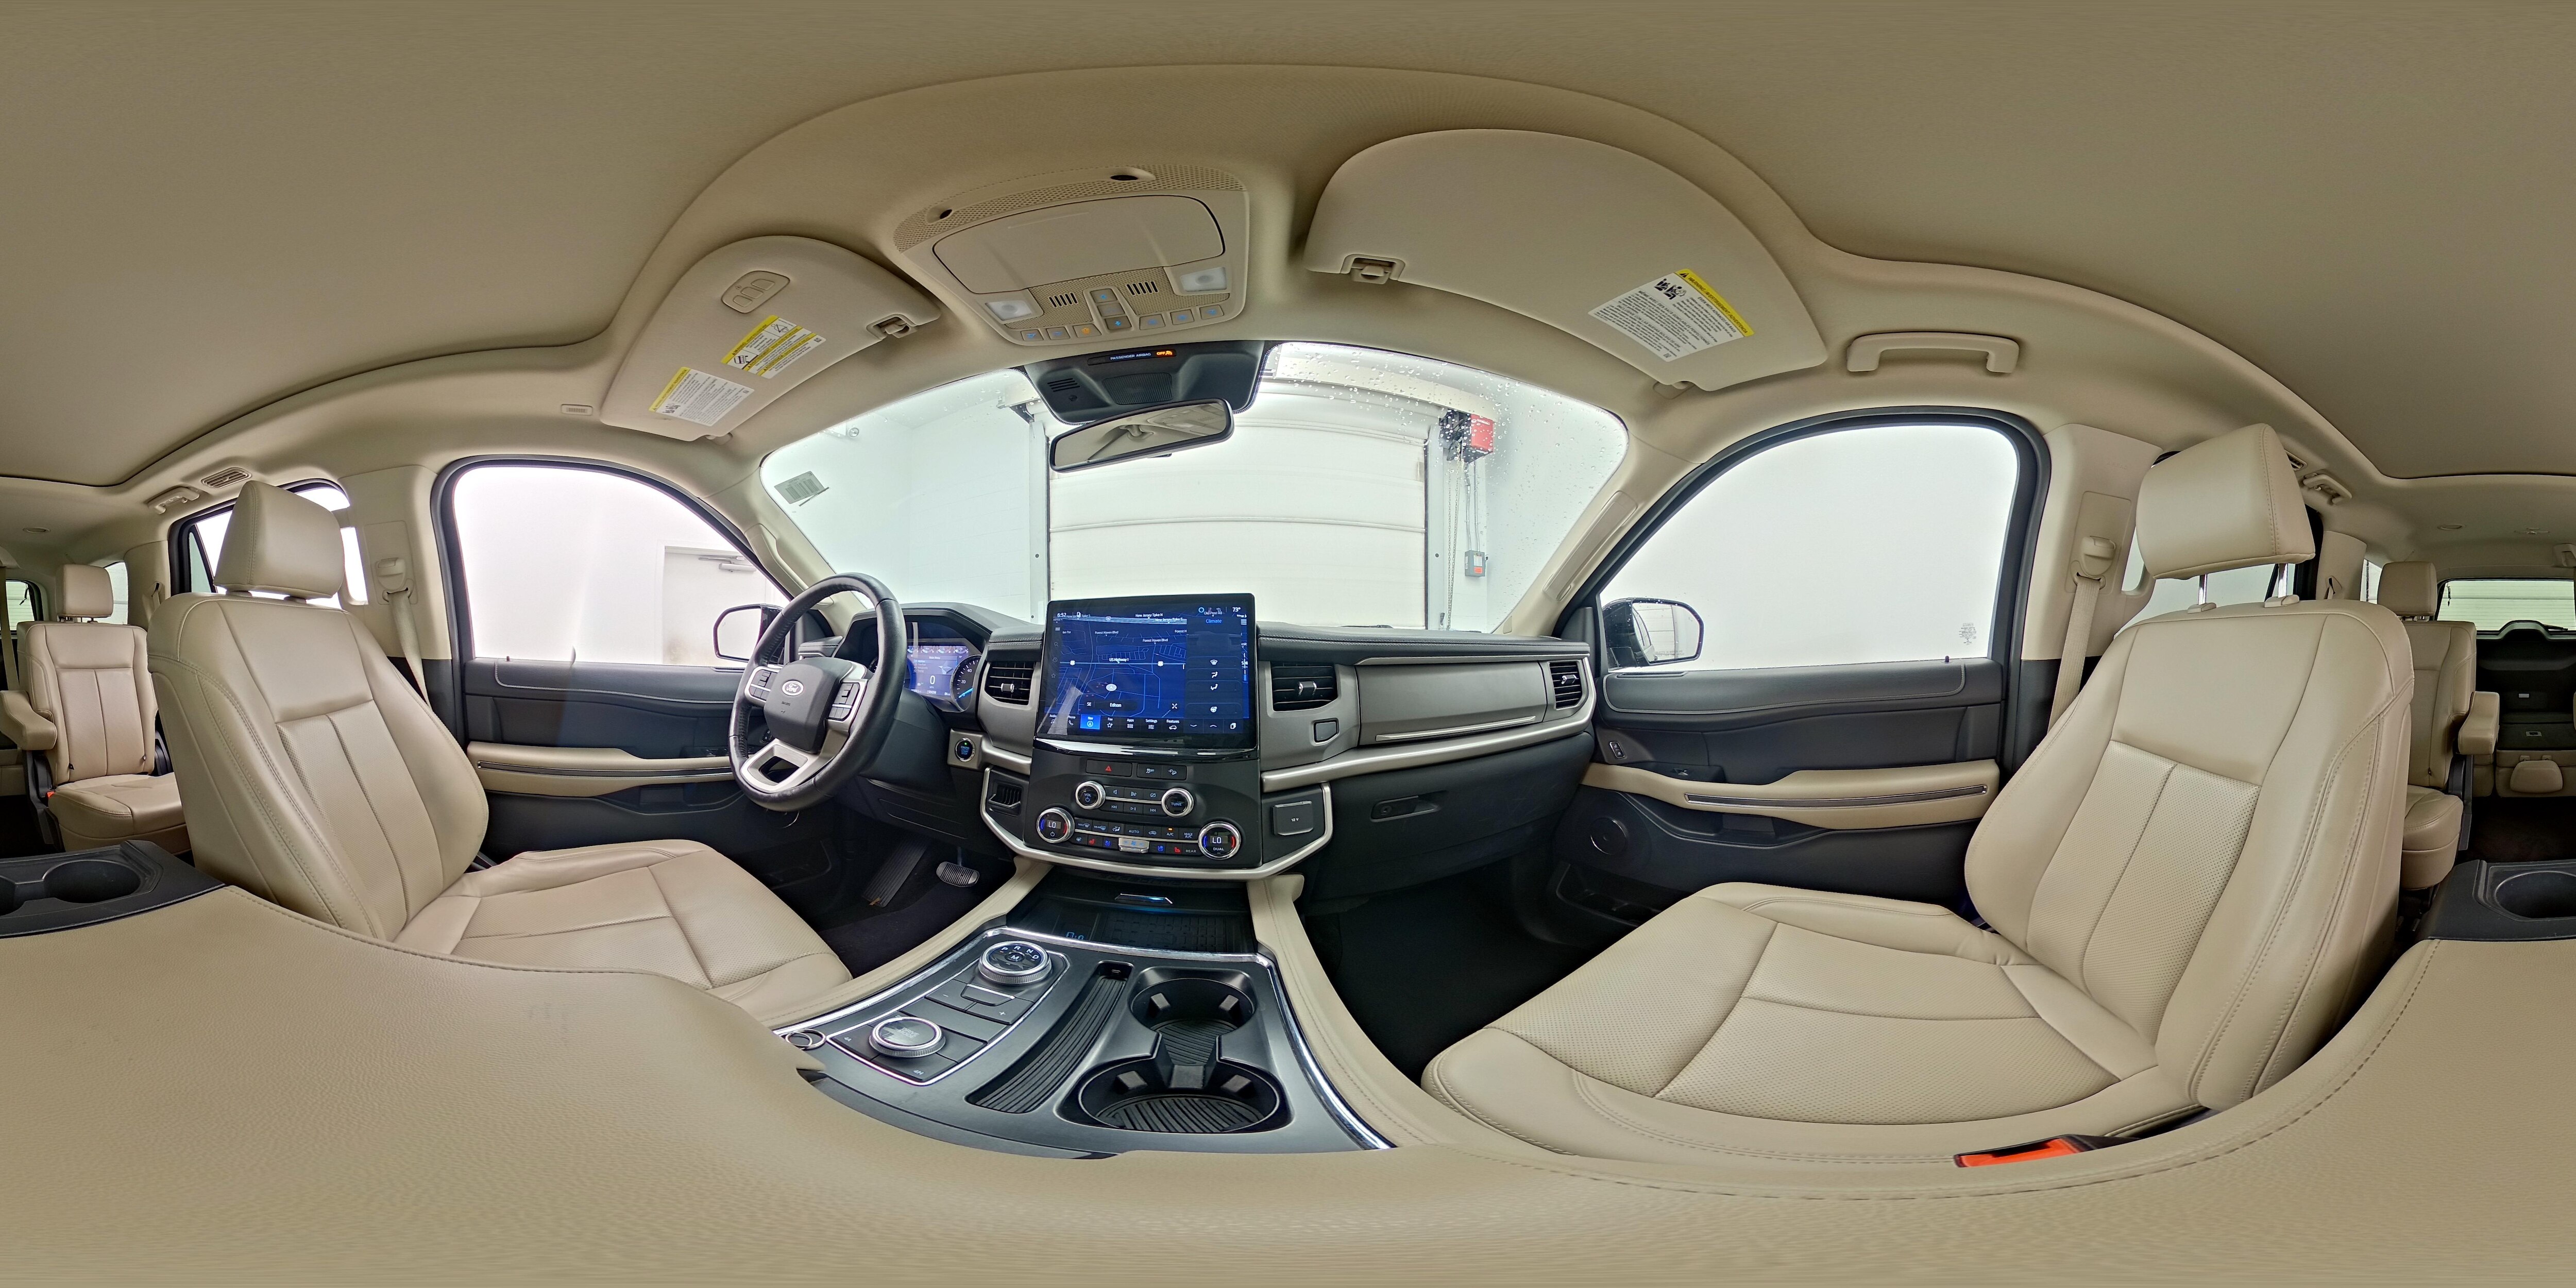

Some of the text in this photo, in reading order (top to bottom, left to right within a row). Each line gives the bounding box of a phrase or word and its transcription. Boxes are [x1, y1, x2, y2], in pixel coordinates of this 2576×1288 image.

[1687, 277, 1706, 291] WARNING
[930, 675, 935, 685] 0
[786, 683, 799, 692] Ford
[899, 1029, 916, 1038] MODE
[902, 1027, 920, 1037] DRIVE
